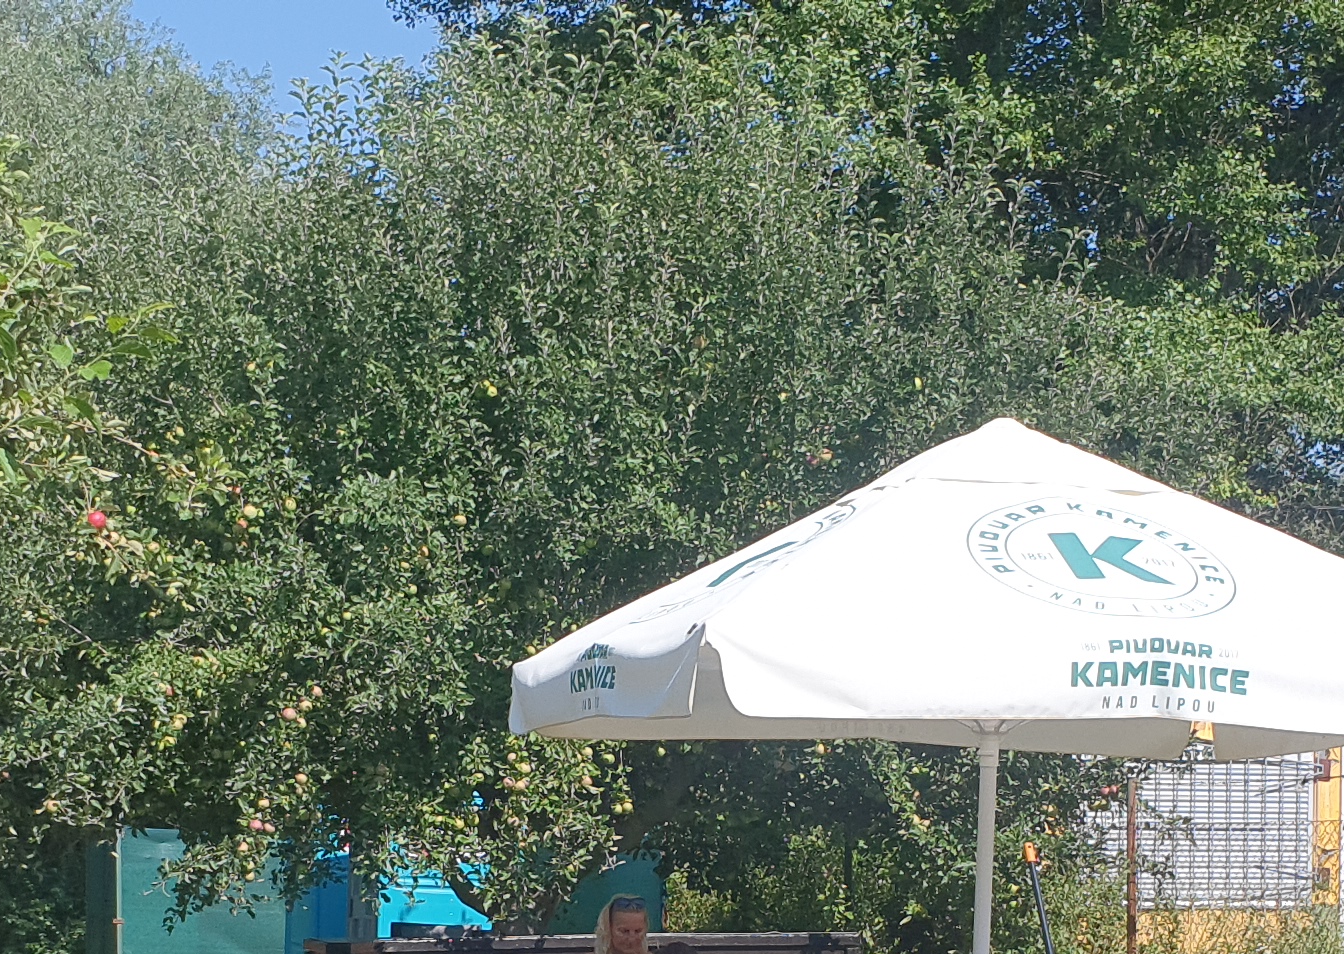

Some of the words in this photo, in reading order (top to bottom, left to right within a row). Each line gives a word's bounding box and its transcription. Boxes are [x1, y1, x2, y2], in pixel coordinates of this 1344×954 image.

[1066, 502, 1225, 585] KAMENICE
[1047, 532, 1176, 585] K
[1049, 591, 1105, 611] NAD
[1218, 647, 1240, 659] 2017
[1070, 660, 1251, 696] KAMENICE
[1101, 694, 1138, 710] NAD
[1151, 694, 1216, 714] LIPOU
